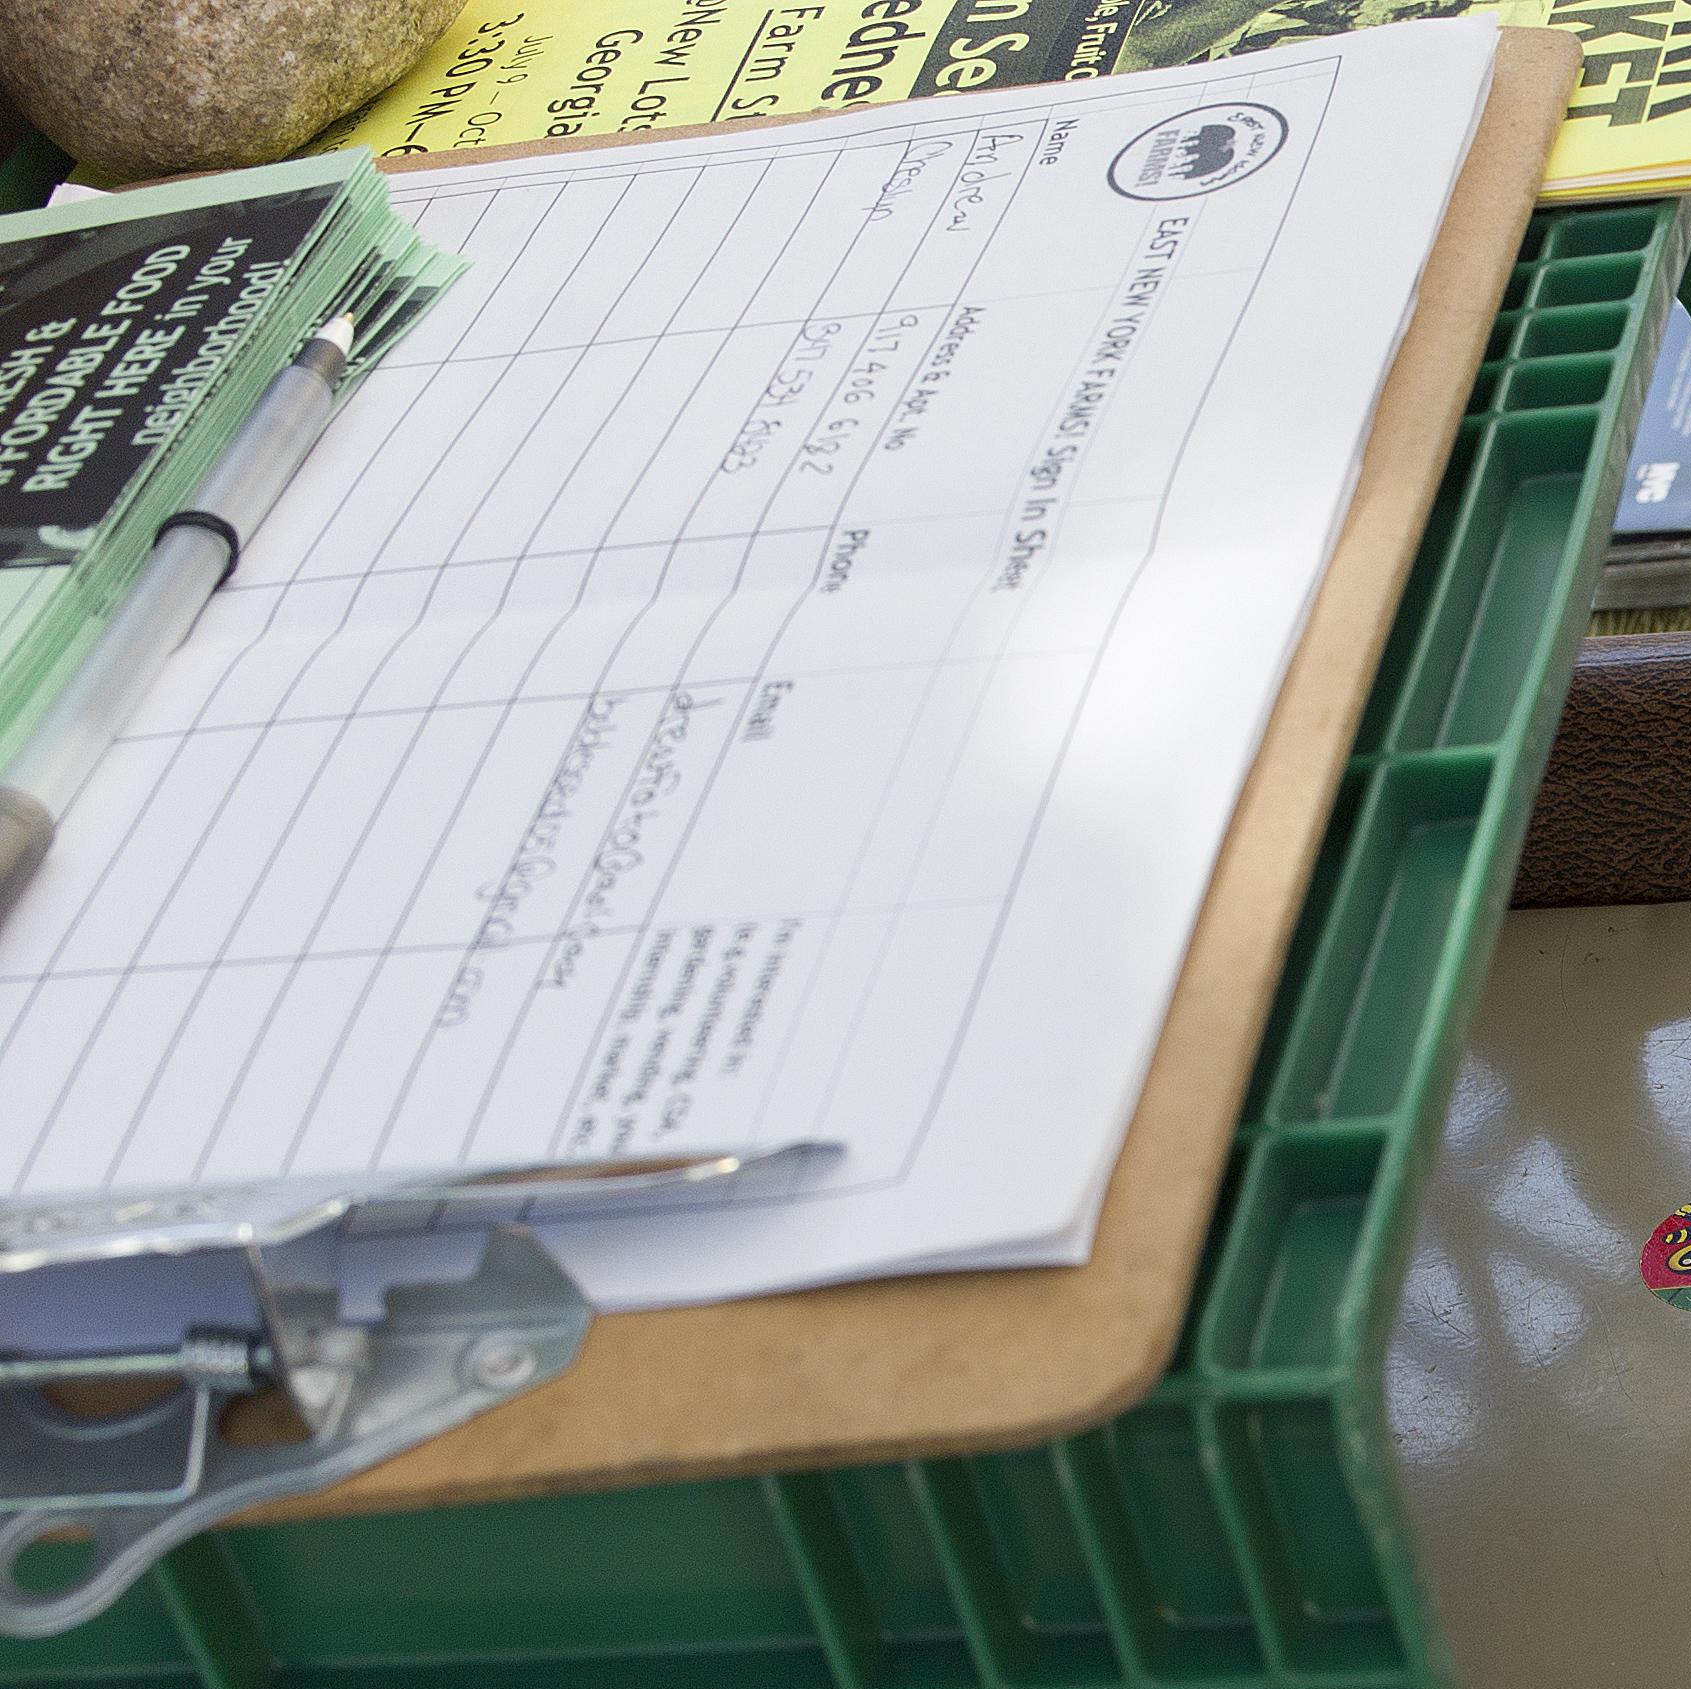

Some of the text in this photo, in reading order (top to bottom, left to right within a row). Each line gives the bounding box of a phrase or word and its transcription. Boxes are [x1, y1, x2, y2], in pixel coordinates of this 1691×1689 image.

[445, 12, 525, 78] 3:30
[743, 6, 825, 83] Farm
[821, 0, 926, 108] edne
[930, 33, 1030, 96] Se
[452, 34, 553, 148] July Oct
[545, 28, 644, 139] Georgia
[1039, 117, 1081, 167] Name
[1134, 127, 1181, 189] FARMS!
[945, 133, 1025, 233] Andrew
[1143, 216, 1190, 261] EAST
[101, 243, 192, 317] FOOD
[1122, 266, 1166, 307] NEW
[21, 236, 254, 494] RIGHT HERE in your
[131, 257, 293, 447] neighborhood!
[931, 305, 987, 368] Address
[1096, 311, 1145, 364] YORK
[1054, 366, 1117, 442] FARMS!
[1029, 444, 1079, 493] Sign
[1020, 497, 1059, 522] In
